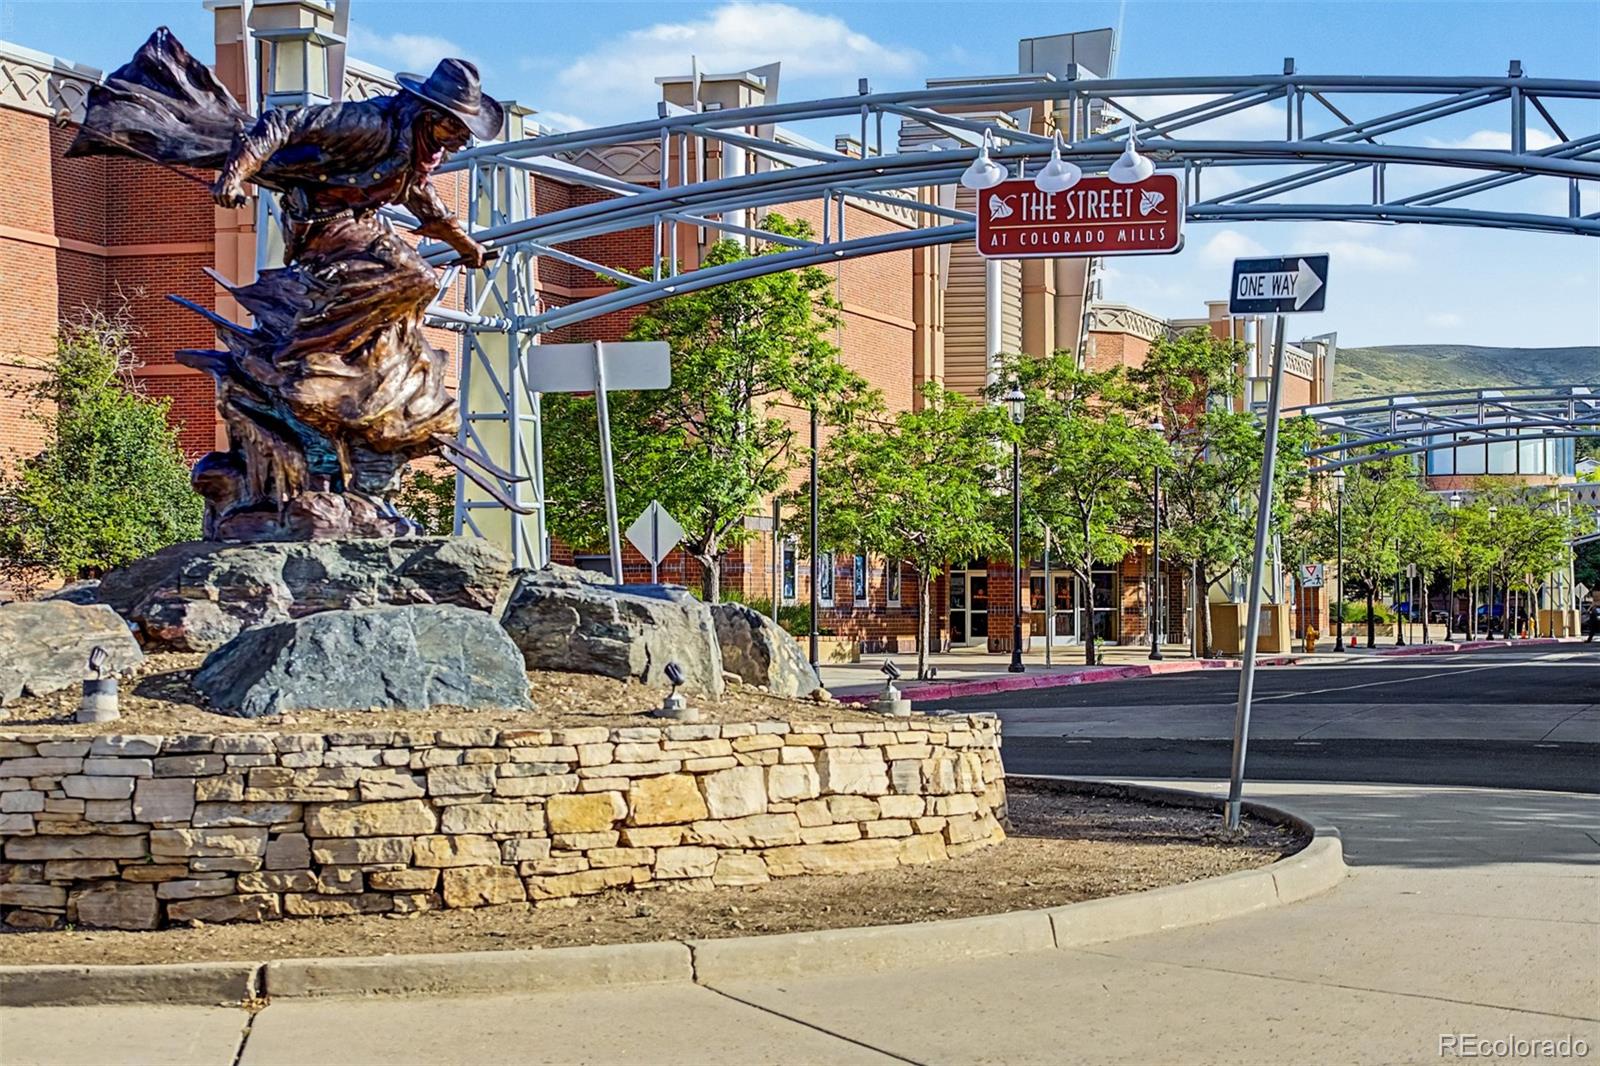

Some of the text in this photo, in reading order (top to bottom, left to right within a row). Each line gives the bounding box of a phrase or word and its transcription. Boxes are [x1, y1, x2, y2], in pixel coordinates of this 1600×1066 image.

[1021, 189, 1133, 221] THE STREET
[991, 227, 1165, 246] AT COLORADO MILLS
[1240, 274, 1298, 296] ONE WAY
